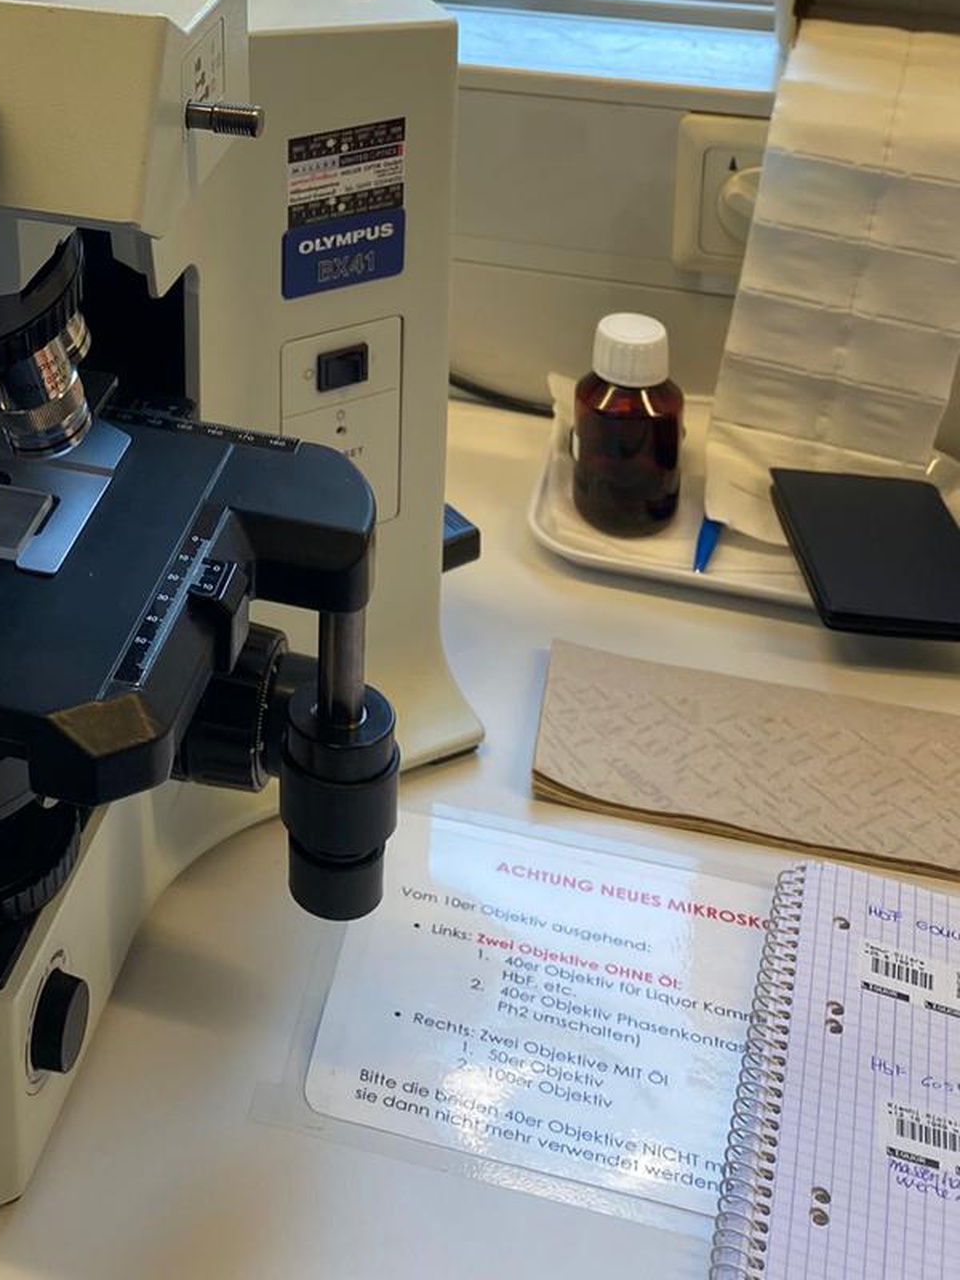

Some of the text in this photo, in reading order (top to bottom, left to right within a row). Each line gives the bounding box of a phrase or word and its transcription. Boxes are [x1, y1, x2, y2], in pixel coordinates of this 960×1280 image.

[298, 222, 395, 255] OLYMPUS
[317, 250, 376, 283] BX41
[496, 862, 595, 892] ACHTUNG
[600, 883, 662, 907] NEUES
[402, 886, 652, 953] Vom 10er Objektiv ausgehend:
[431, 923, 473, 941] Links:
[476, 932, 514, 950] Zwei
[518, 943, 599, 970] Objektive
[604, 962, 654, 984] OHNE
[470, 977, 485, 992] 2.
[500, 986, 536, 1003] 40er
[540, 995, 613, 1021] Objektiv
[477, 949, 490, 961] 1.
[505, 955, 540, 972] 40er
[544, 963, 615, 988] Objektiv
[619, 981, 641, 997] für
[645, 987, 698, 1009] Liquor
[543, 982, 577, 998] etc.
[497, 1000, 641, 1048] Ph2 umschalten)
[412, 1012, 669, 1086] Rechts: Zwei Objektive MIT Öl
[489, 1049, 527, 1070] 50er
[530, 1060, 604, 1088] Objektiv
[489, 1066, 533, 1089] 100er
[538, 1080, 613, 1108] Objektiv
[355, 1087, 720, 1193] sie dann nicht mehr verwendet werden
[359, 1068, 397, 1090] Bitte
[402, 1081, 430, 1098] die
[435, 1089, 499, 1116] beiden
[504, 1109, 542, 1129] 40er
[548, 1119, 637, 1152] Objektive
[642, 1141, 701, 1168] NICHT
